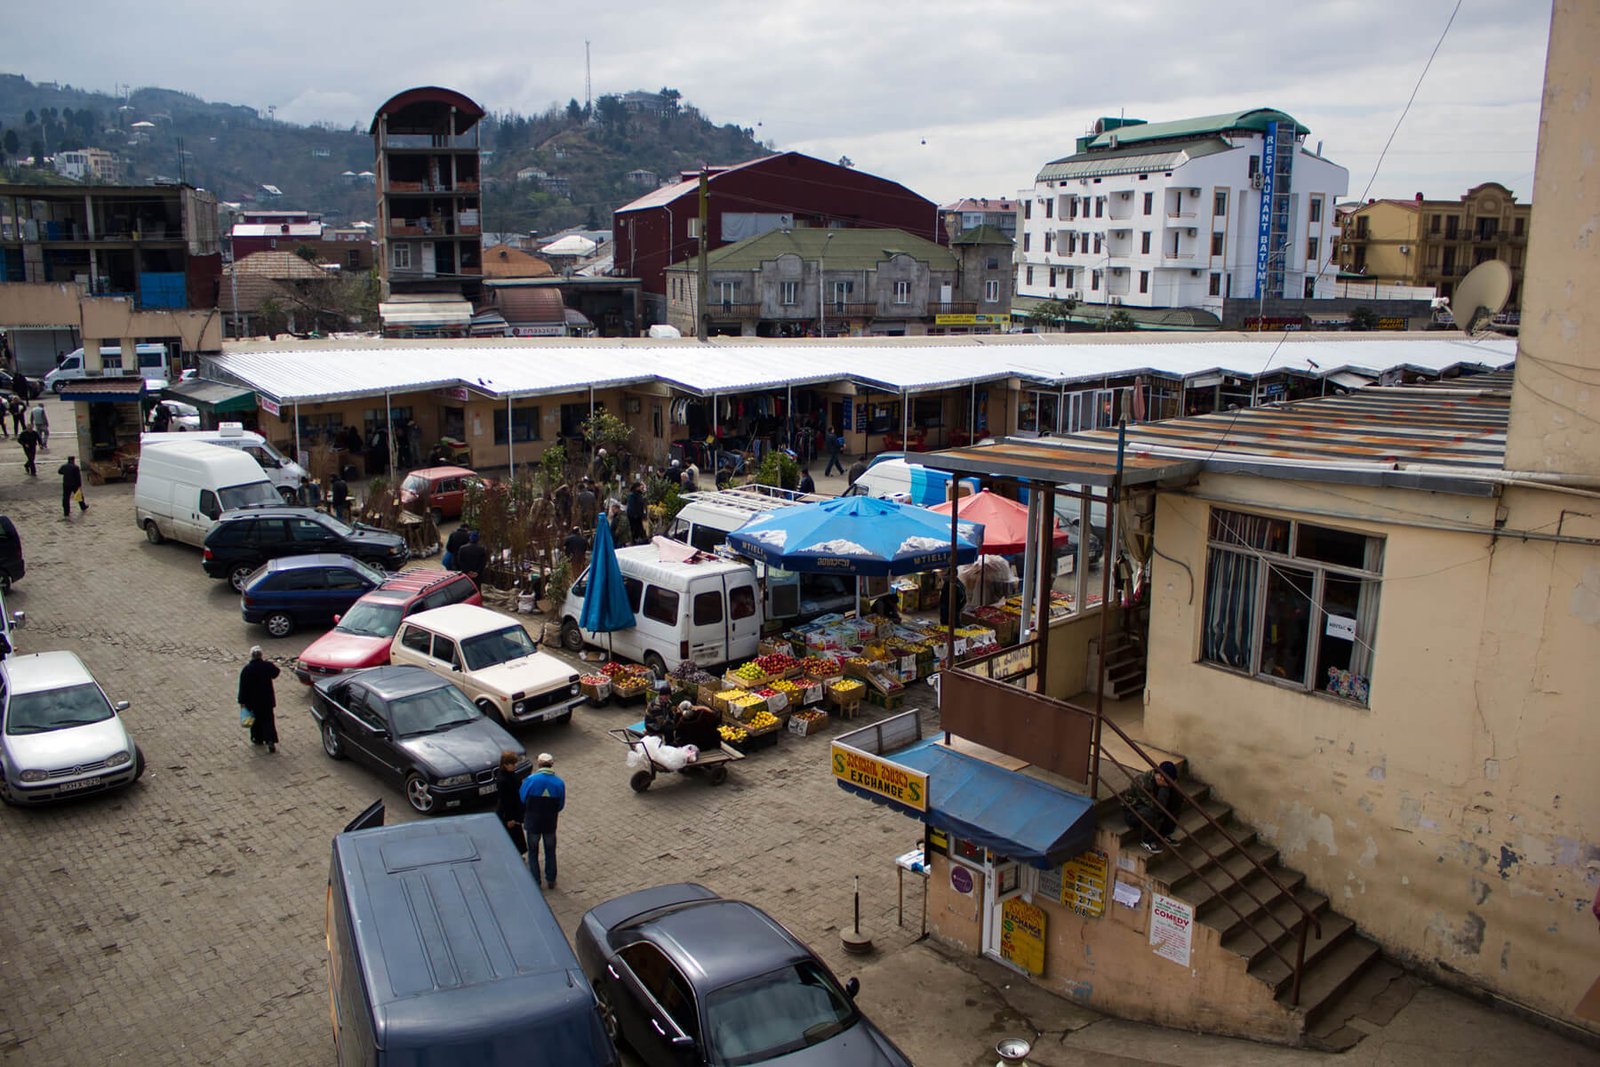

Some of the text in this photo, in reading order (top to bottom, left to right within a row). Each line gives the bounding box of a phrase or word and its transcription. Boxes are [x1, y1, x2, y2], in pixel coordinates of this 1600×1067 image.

[1261, 135, 1275, 231] RESTAURANT
[742, 541, 764, 555] MTIELI
[913, 552, 947, 565] MTIELI
[850, 769, 904, 799] EXCHANGE
[1154, 907, 1190, 927] COMEDY
